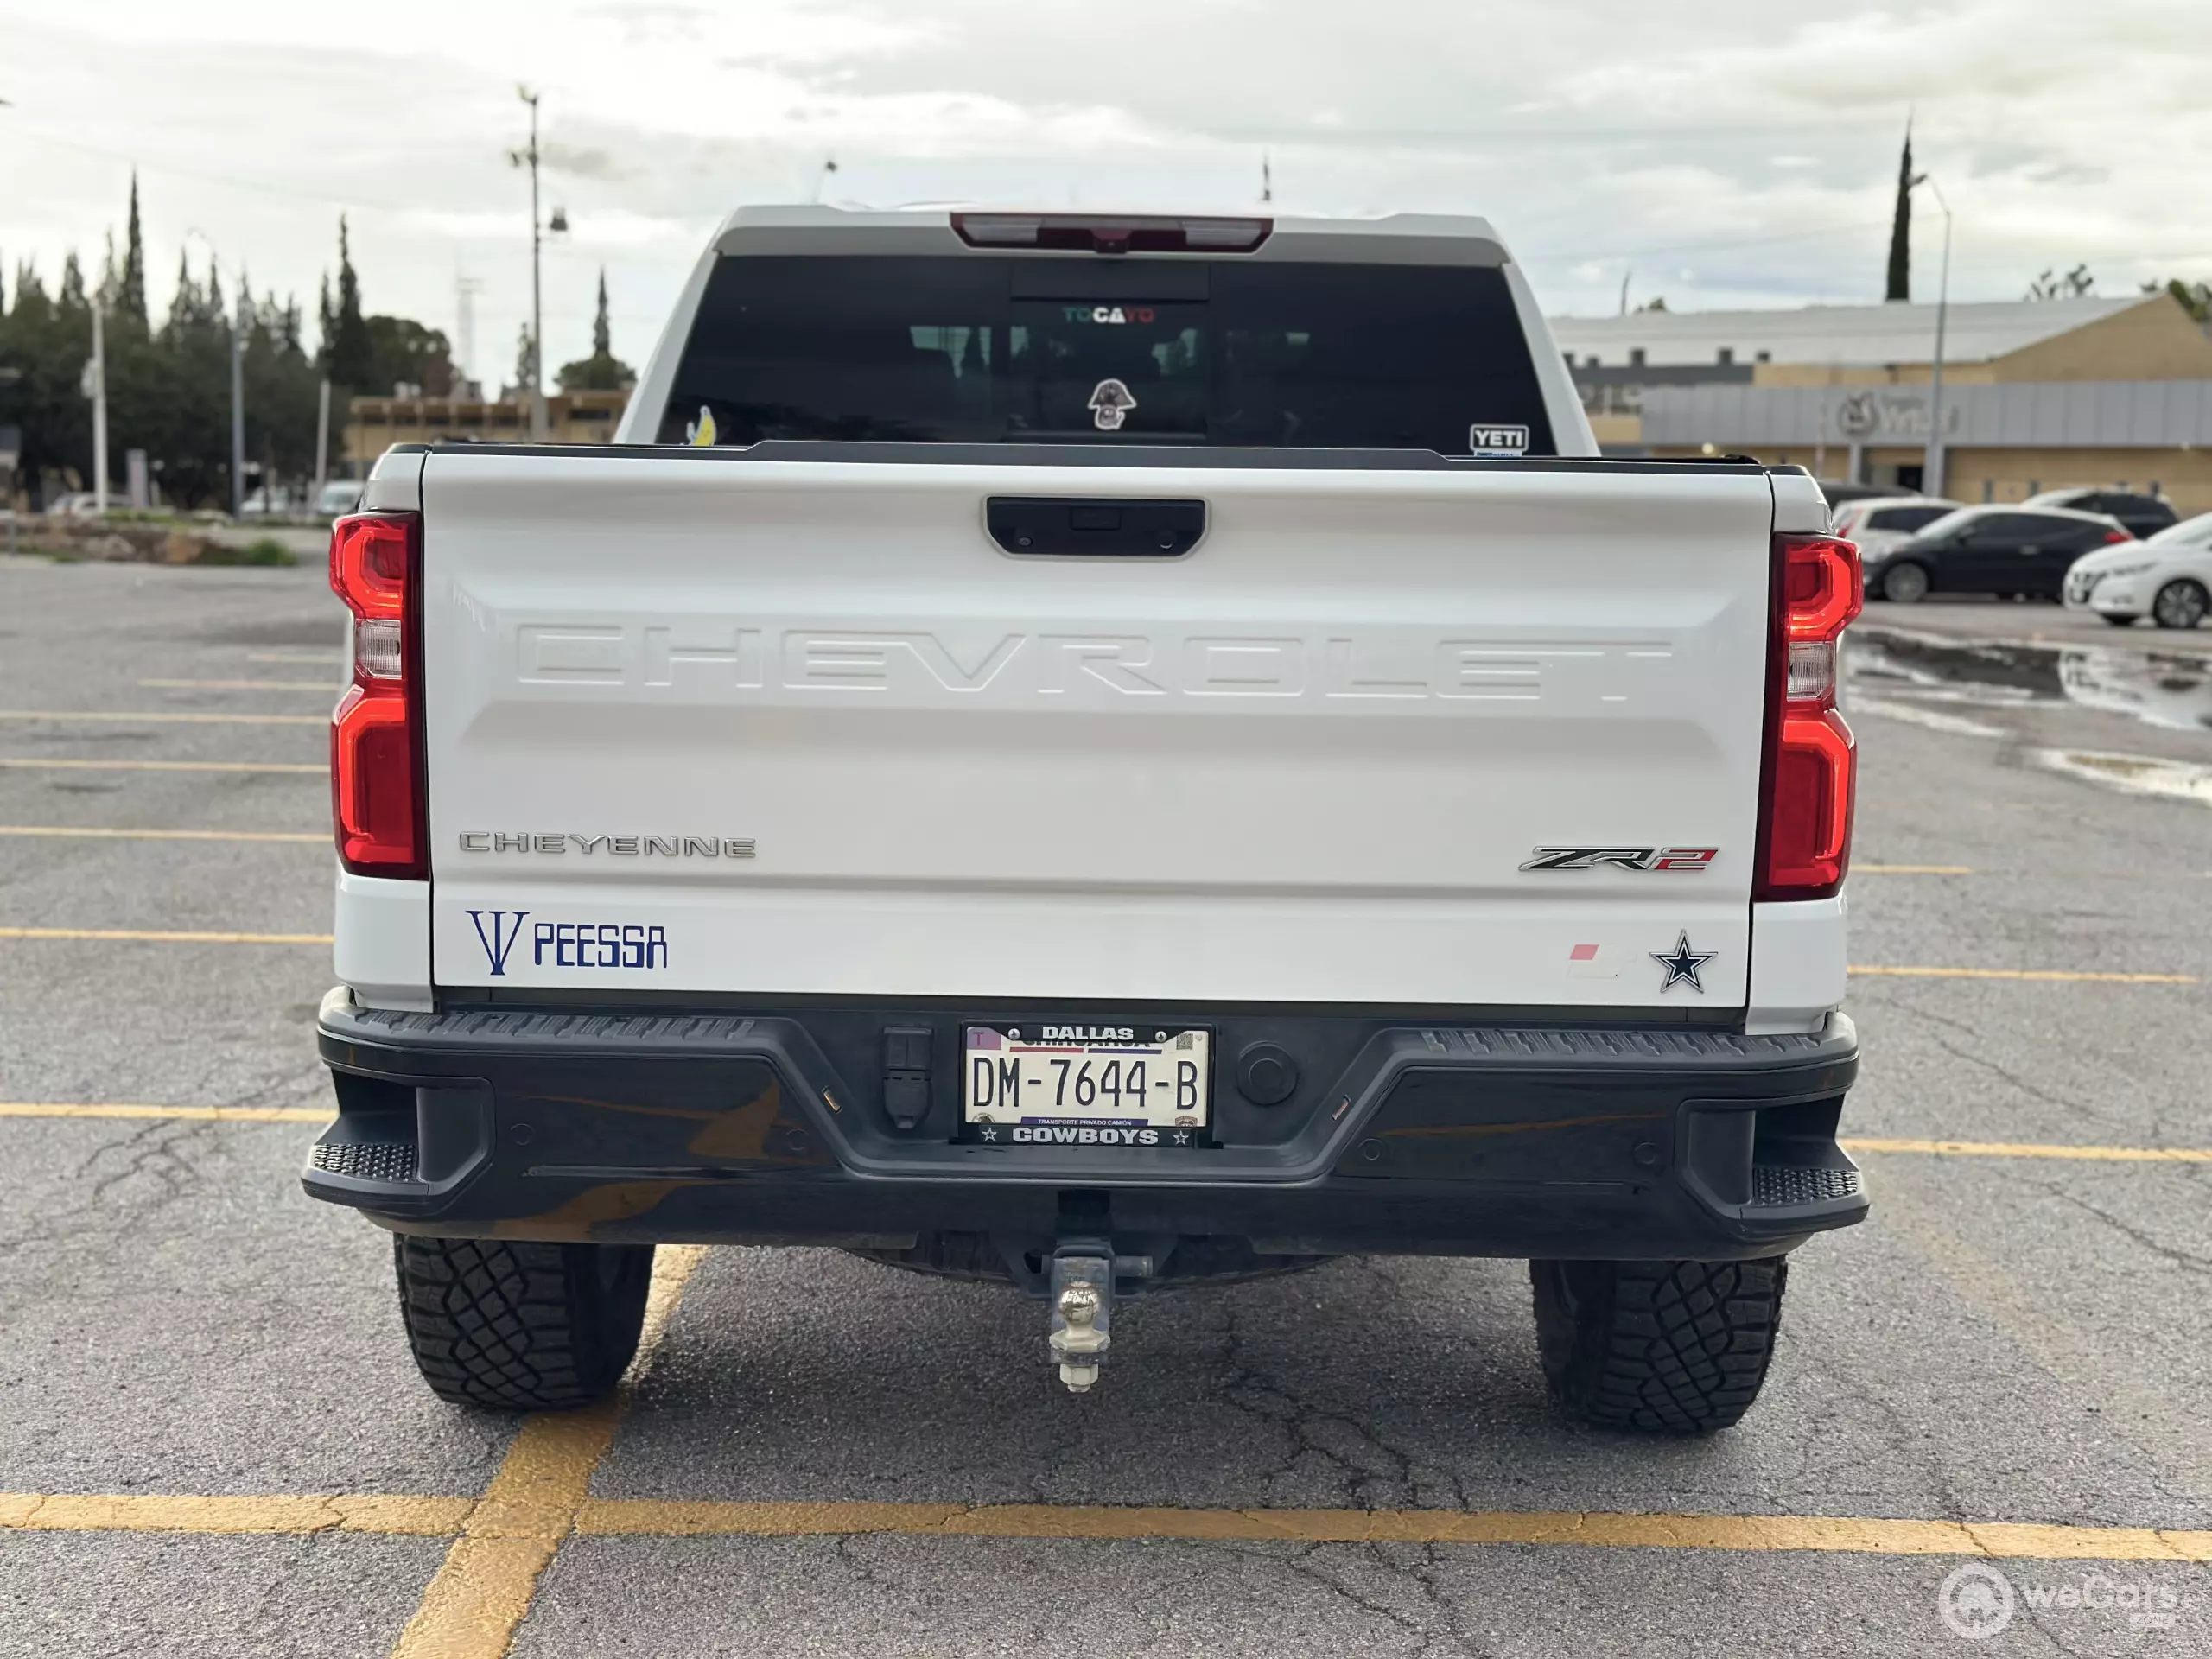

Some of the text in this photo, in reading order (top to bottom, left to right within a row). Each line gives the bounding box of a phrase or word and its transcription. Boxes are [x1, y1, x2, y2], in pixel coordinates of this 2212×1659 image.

[1062, 307, 1155, 324] TOCAYO
[1475, 429, 1523, 447] YETI
[518, 623, 1672, 700] CHEVROLET
[460, 831, 755, 858] CHEYENNE
[1519, 847, 1719, 870] ZR2
[534, 923, 667, 969] PEESSA
[1042, 1027, 1134, 1040] DALLAS
[973, 1057, 1198, 1110] DM-7644-B
[1013, 1128, 1159, 1145] COWBOYS
